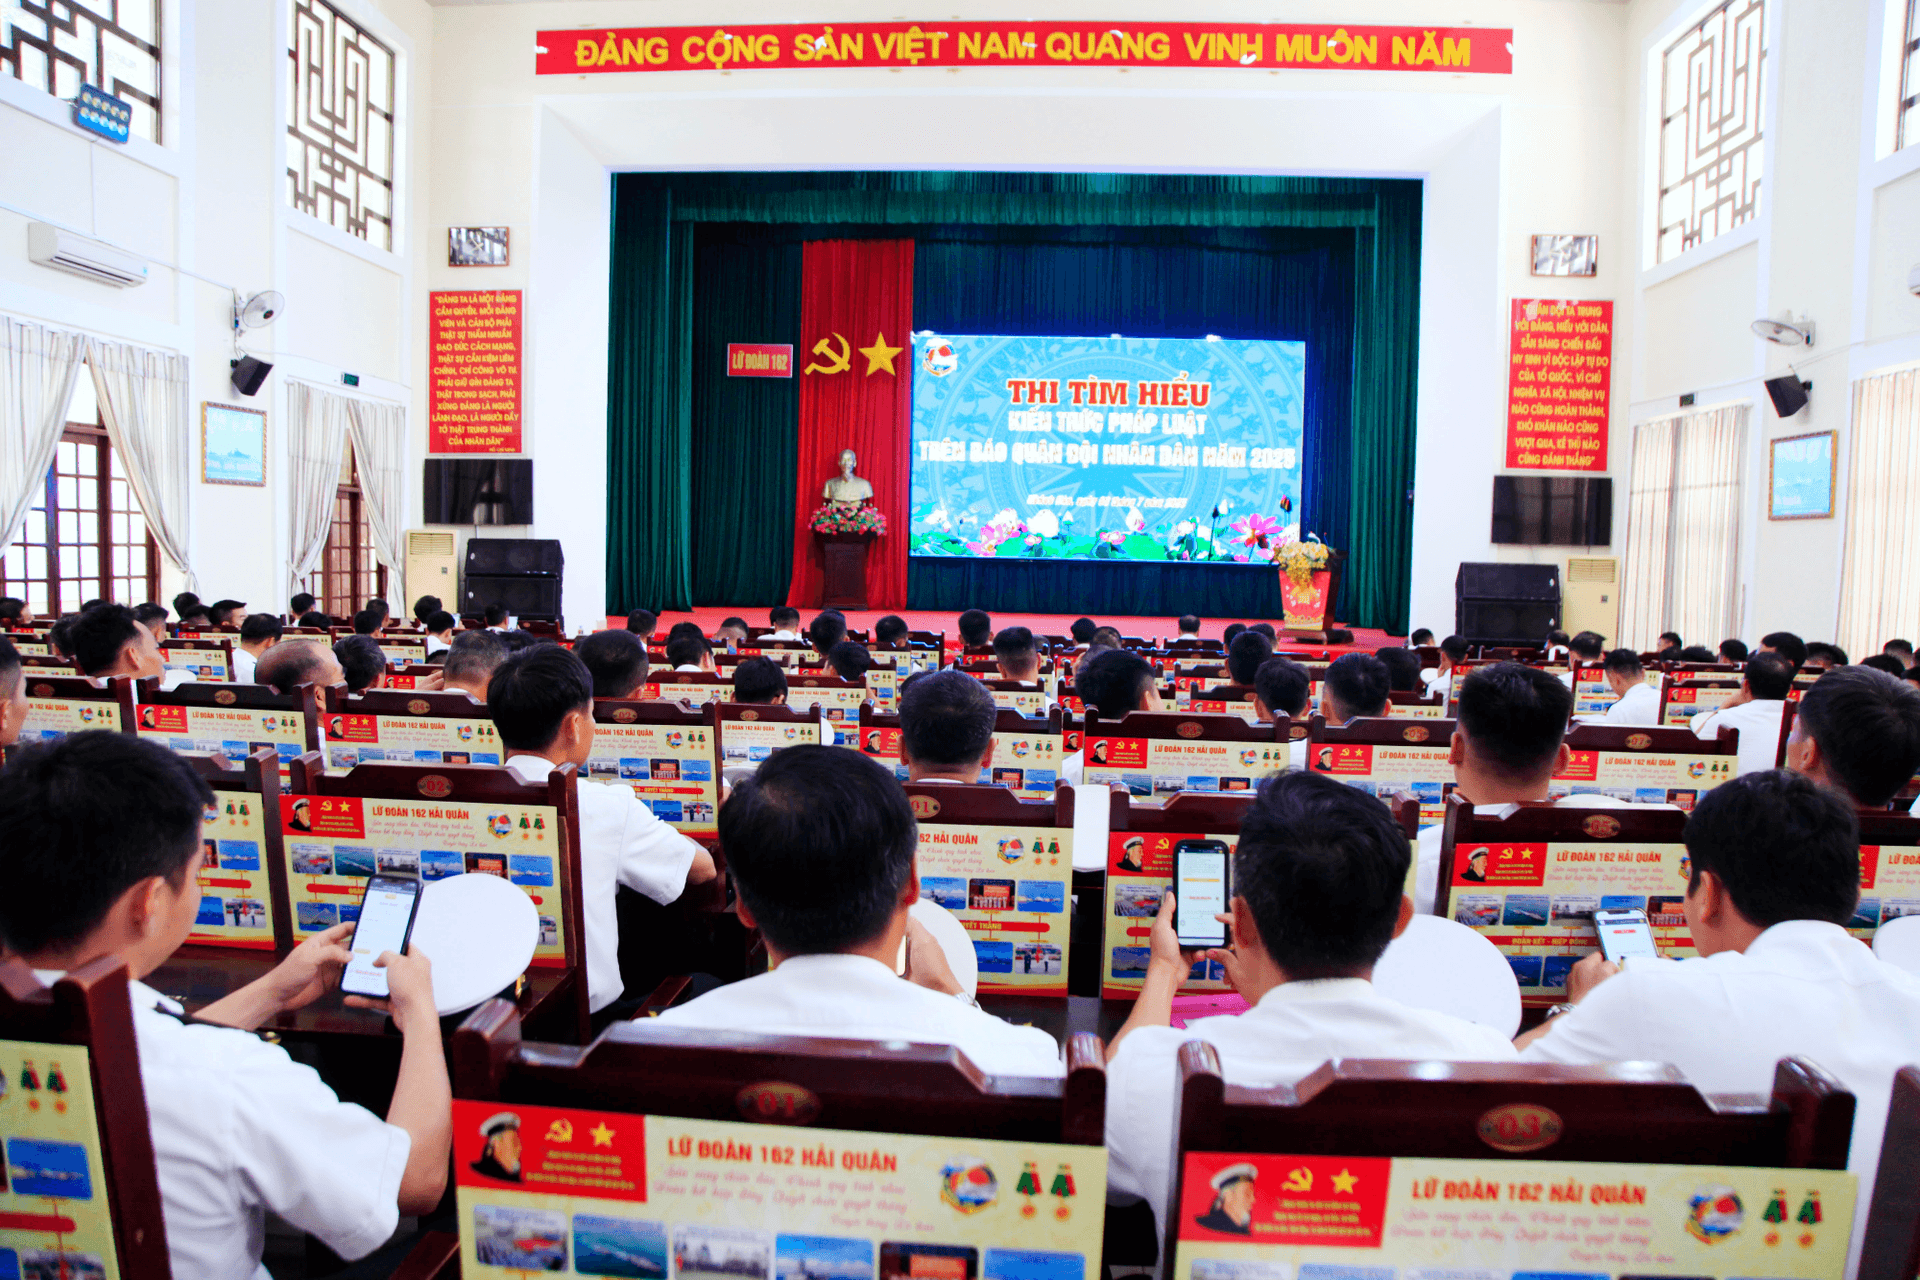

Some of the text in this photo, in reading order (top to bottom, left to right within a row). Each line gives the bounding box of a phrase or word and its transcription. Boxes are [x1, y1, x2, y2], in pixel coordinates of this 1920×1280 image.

[575, 25, 1470, 69] ĐẢNG CỘNG SẢN VIỆT NAM QUANG VINH MUÔN NĂM
[1007, 371, 1211, 407] THI TÌM HIỂU
[1008, 405, 1208, 438] KIẾN THỨC PHÁP LUẬT
[919, 437, 1295, 469] TRÊN BÁO QUÂN ĐỘI NHÂN DÂN NĂM 2025
[427, 780, 445, 792] 02
[372, 805, 469, 820] LỮ ĐOÀN 162 HẢI QUÂN
[919, 830, 978, 845] 62 HẢI QUÂN
[1557, 849, 1661, 863] LỮ ĐOÀN 162 HẢI QUÂN
[668, 1134, 897, 1172] LỮ ĐOÀN 162 HẢI QUÂN
[1412, 1175, 1647, 1206] LỮ ĐOÀN 162 HẢI QUÂN
